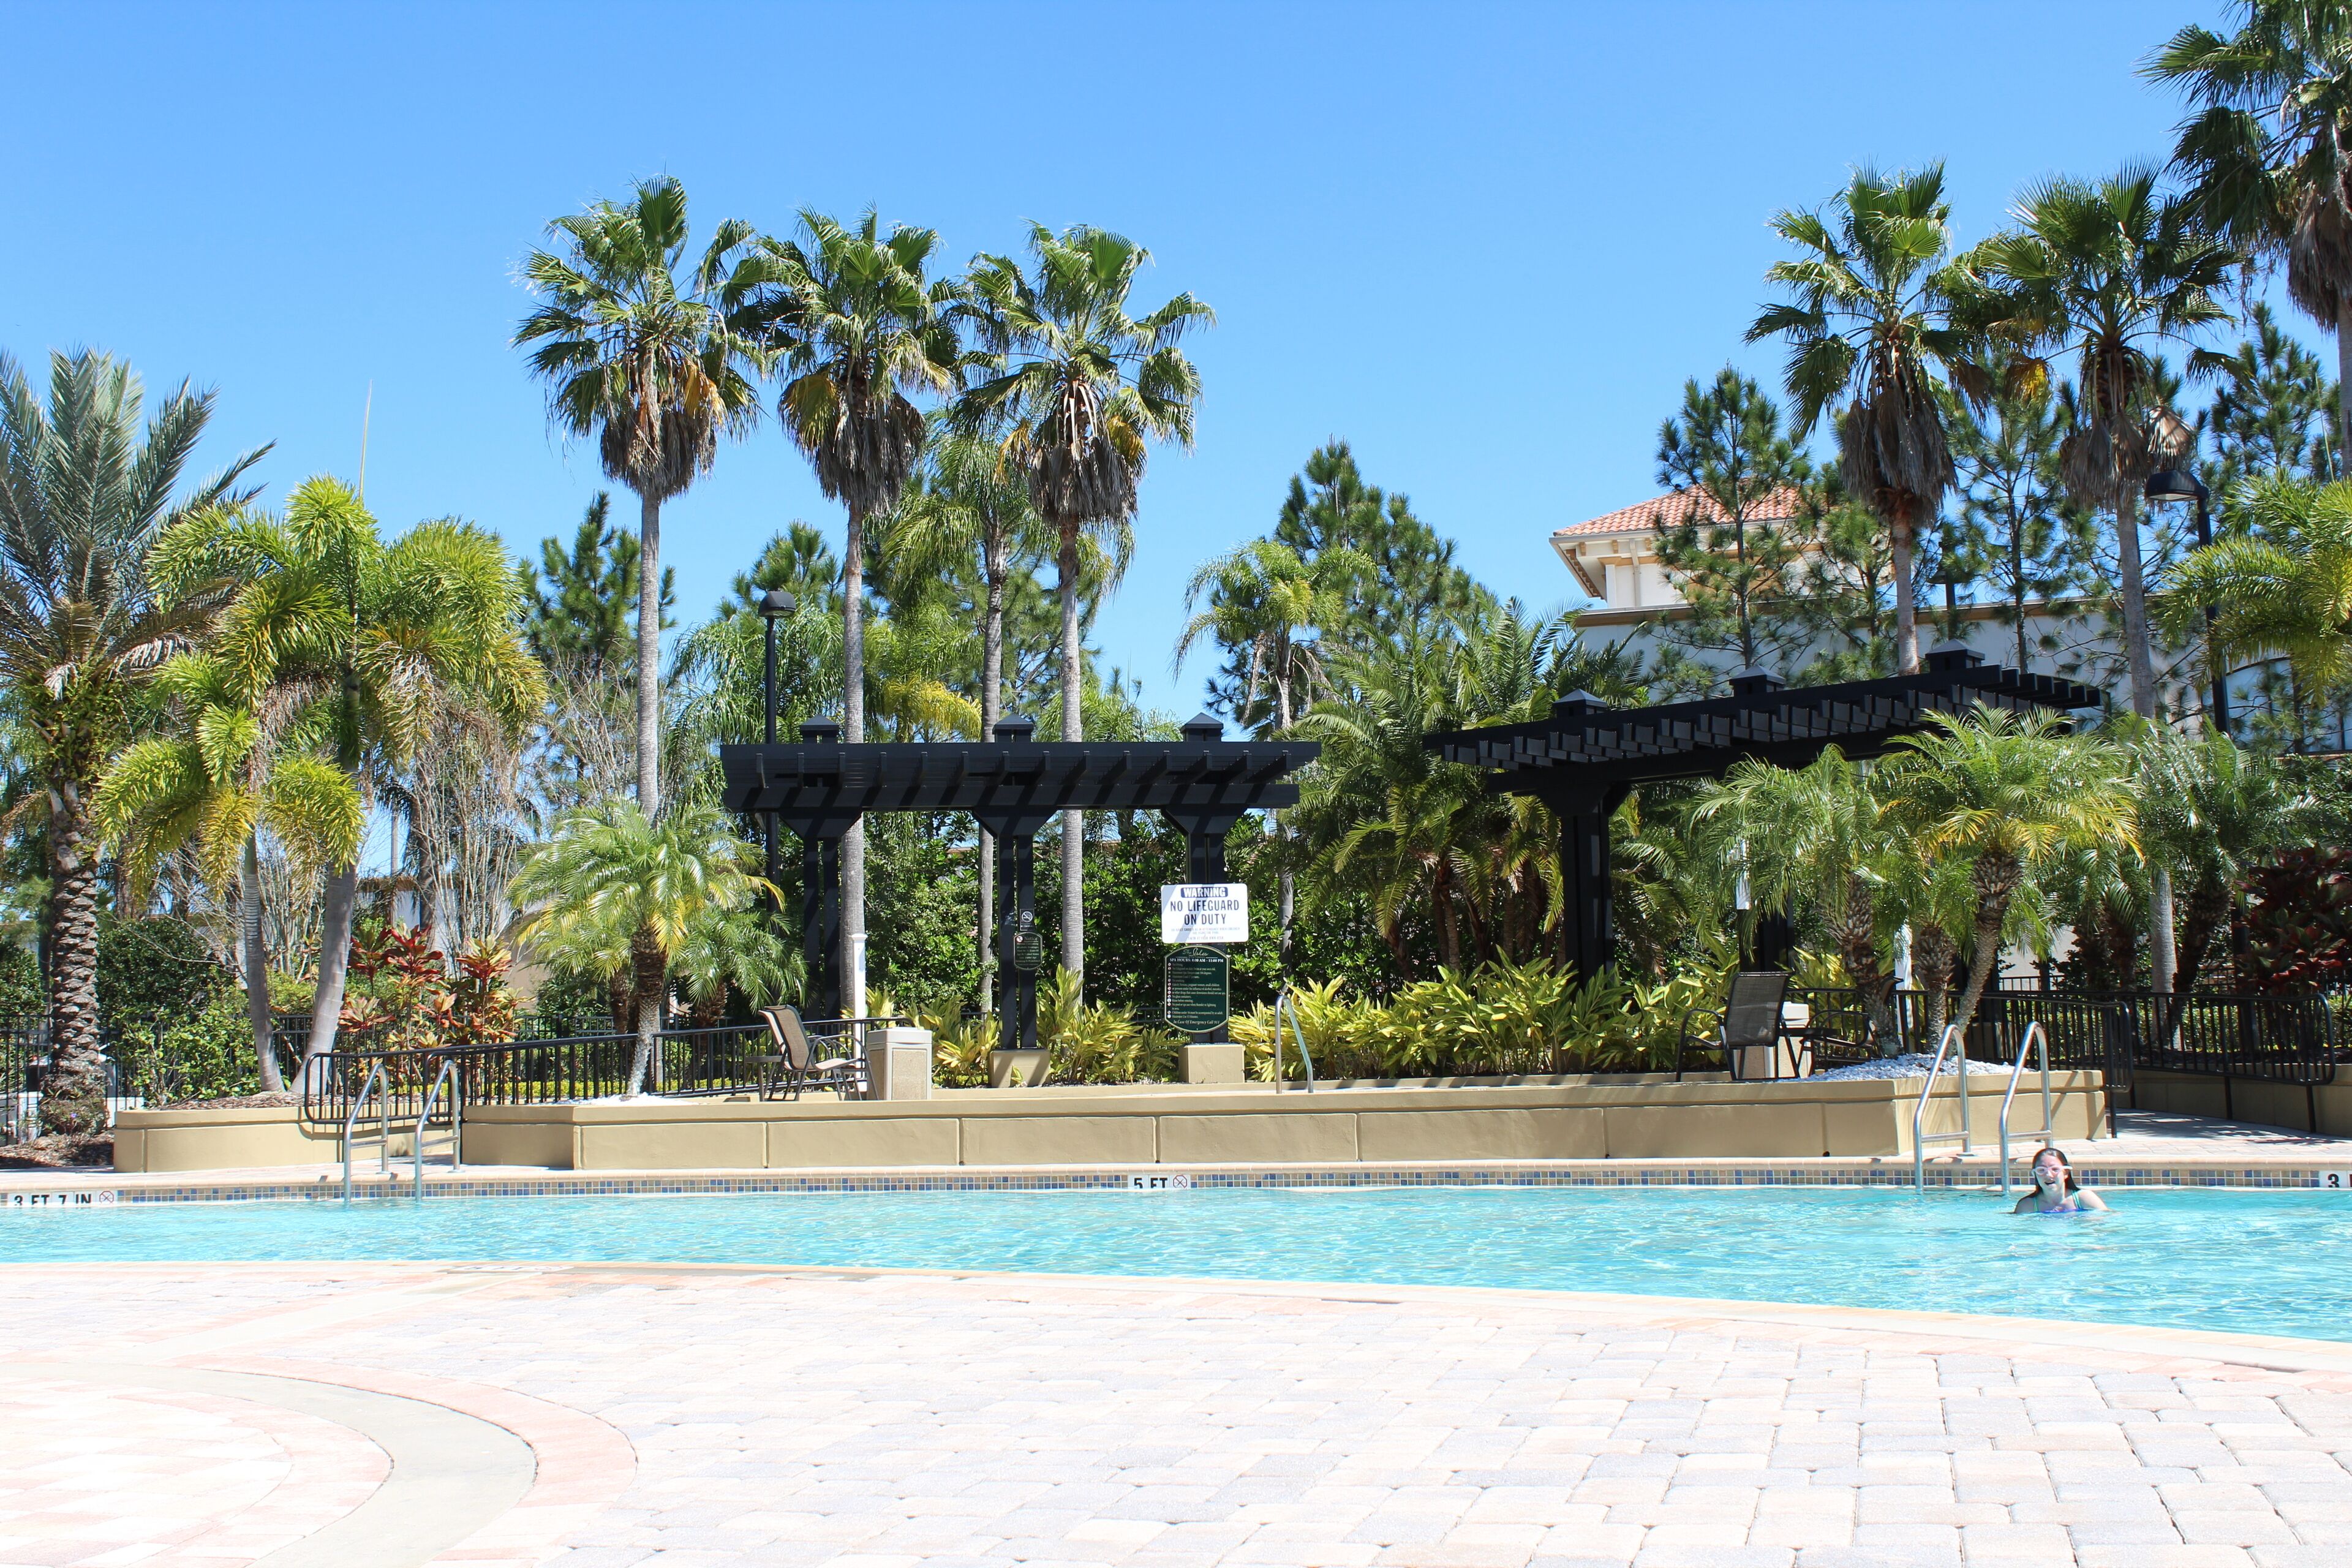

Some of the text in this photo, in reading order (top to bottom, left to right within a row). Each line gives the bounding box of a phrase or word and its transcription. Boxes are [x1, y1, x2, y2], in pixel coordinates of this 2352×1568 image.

[1183, 888, 1226, 898] WARNING
[1170, 900, 1240, 911] NO LIFEGUARD
[1184, 913, 1226, 925] ON DUTY
[1189, 948, 1208, 956] Isles
[1134, 1177, 1168, 1189] 5 FT
[2328, 1174, 2340, 1188] 3
[14, 1194, 92, 1205] 3 FT 7 IN
